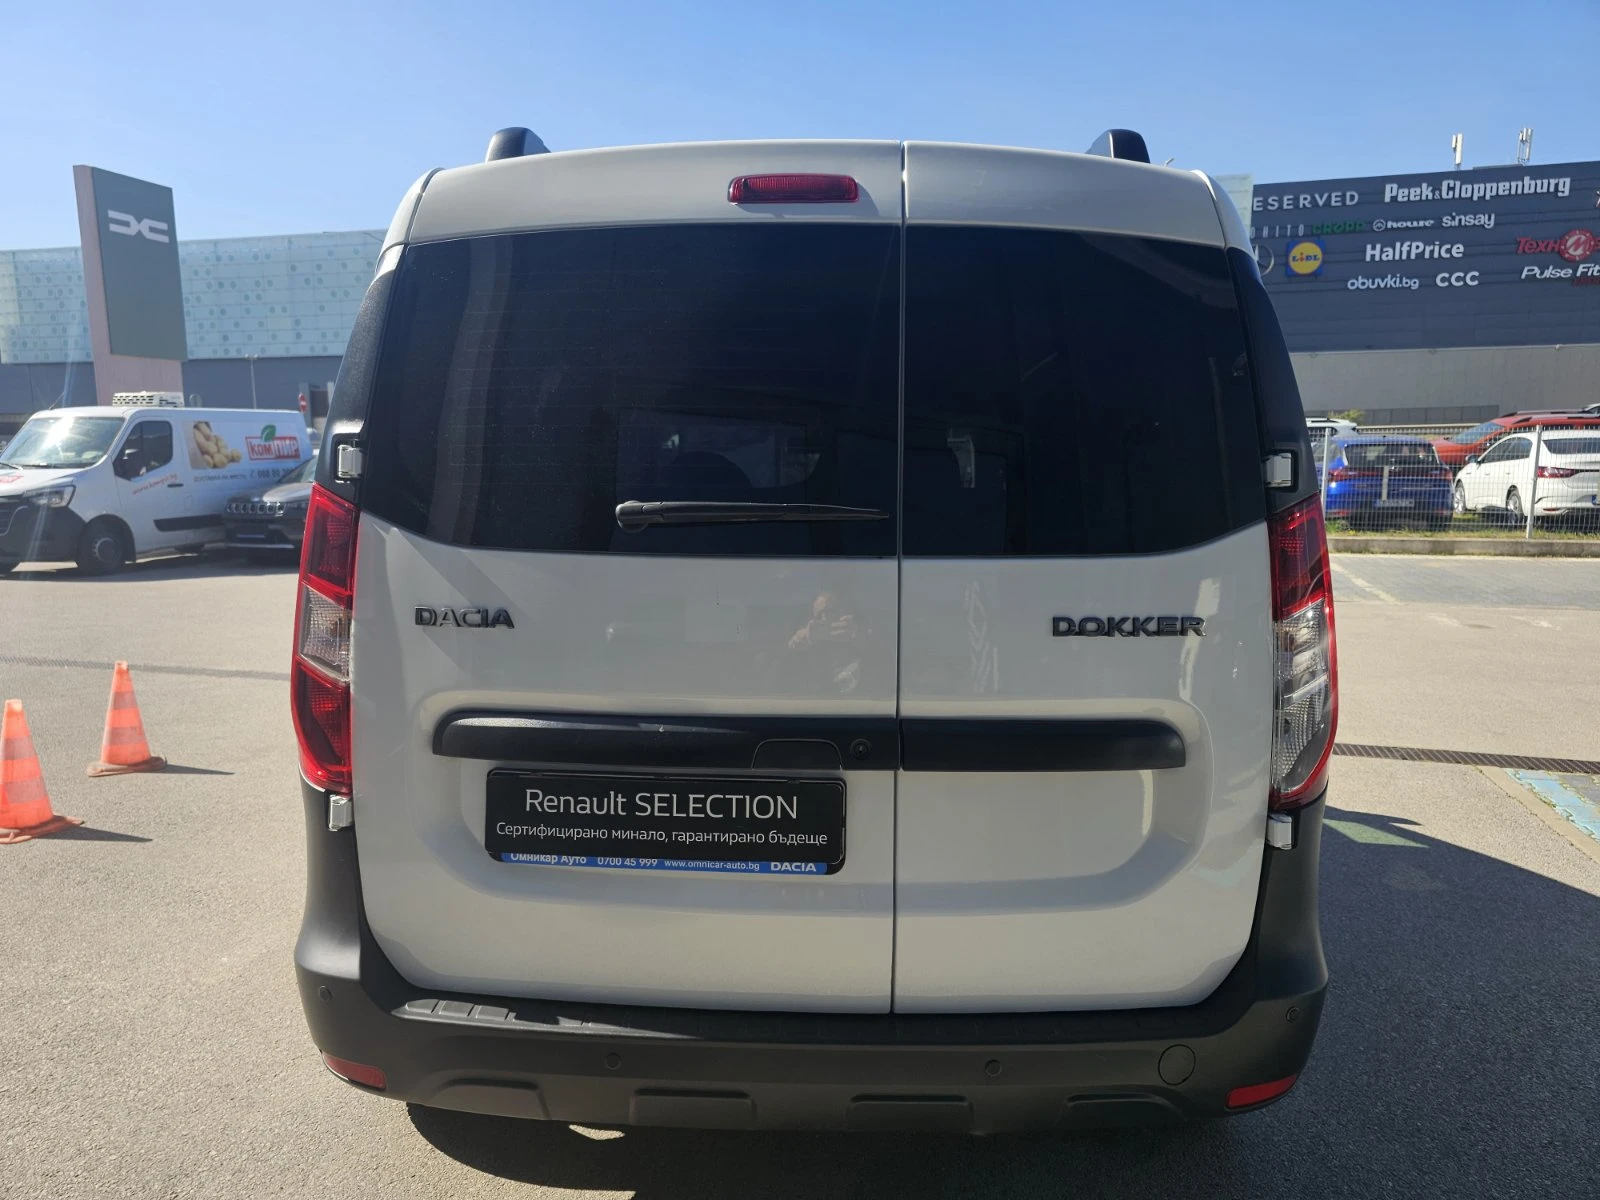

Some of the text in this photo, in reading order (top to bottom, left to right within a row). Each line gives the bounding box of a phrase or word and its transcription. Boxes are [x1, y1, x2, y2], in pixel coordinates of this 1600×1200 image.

[1252, 191, 1359, 211] ESERVED
[1441, 212, 1495, 229] sinsay
[1250, 223, 1305, 239] OHITO
[1365, 240, 1465, 262] HalfPrice
[1347, 273, 1420, 290] obuvki.bg
[1435, 270, 1480, 287] CCC
[1520, 265, 1573, 279] Pulse
[414, 606, 515, 629] DACIA
[1052, 616, 1206, 638] DOKKER
[525, 788, 798, 820] Renault SELECTION
[496, 822, 828, 847] Сертифицирано минало, гарантирано бъдеще
[560, 855, 588, 866] Ауто
[597, 857, 622, 867] 0700
[624, 858, 637, 867] 45
[639, 858, 659, 868] 999
[664, 859, 760, 872] www.omnicar-auto.bg
[770, 861, 817, 873] DACIA
